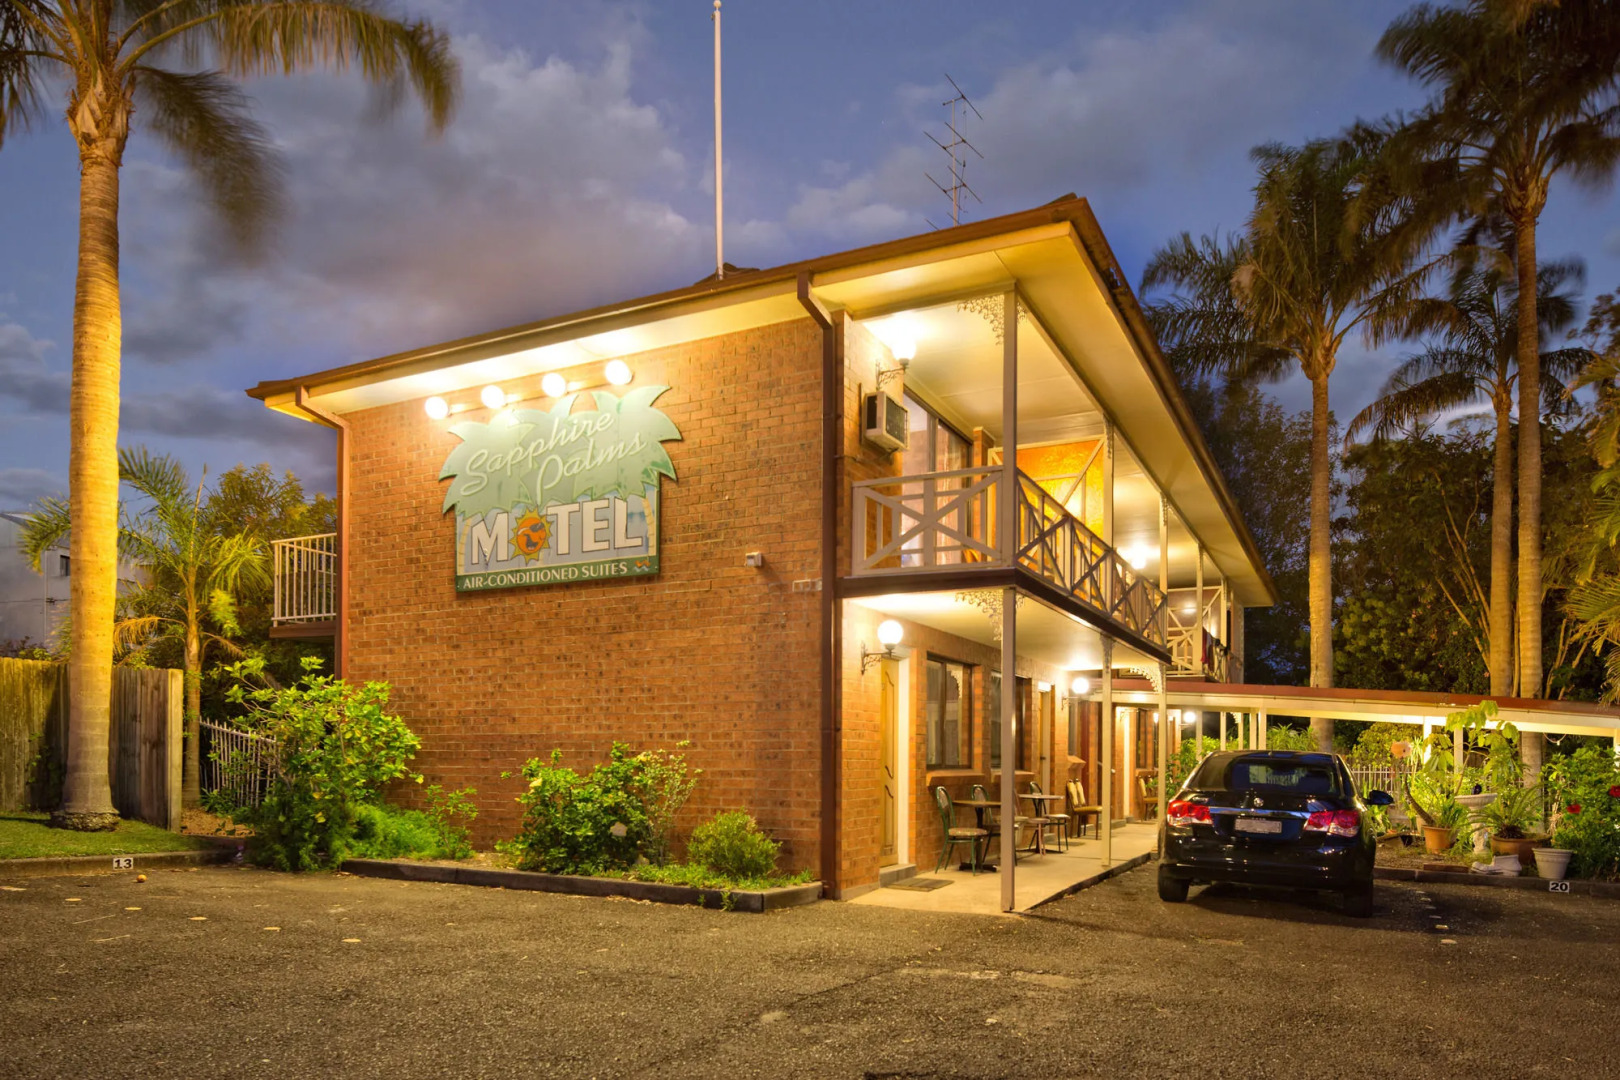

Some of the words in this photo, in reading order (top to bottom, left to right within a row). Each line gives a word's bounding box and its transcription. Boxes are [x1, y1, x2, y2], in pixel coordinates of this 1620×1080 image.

[460, 412, 614, 496] Sapphire
[537, 432, 647, 504] Palms
[463, 564, 578, 589] AIR-CONDITIONED
[582, 562, 628, 578] SUITES
[114, 859, 132, 869] 13
[1550, 882, 1568, 891] 20
